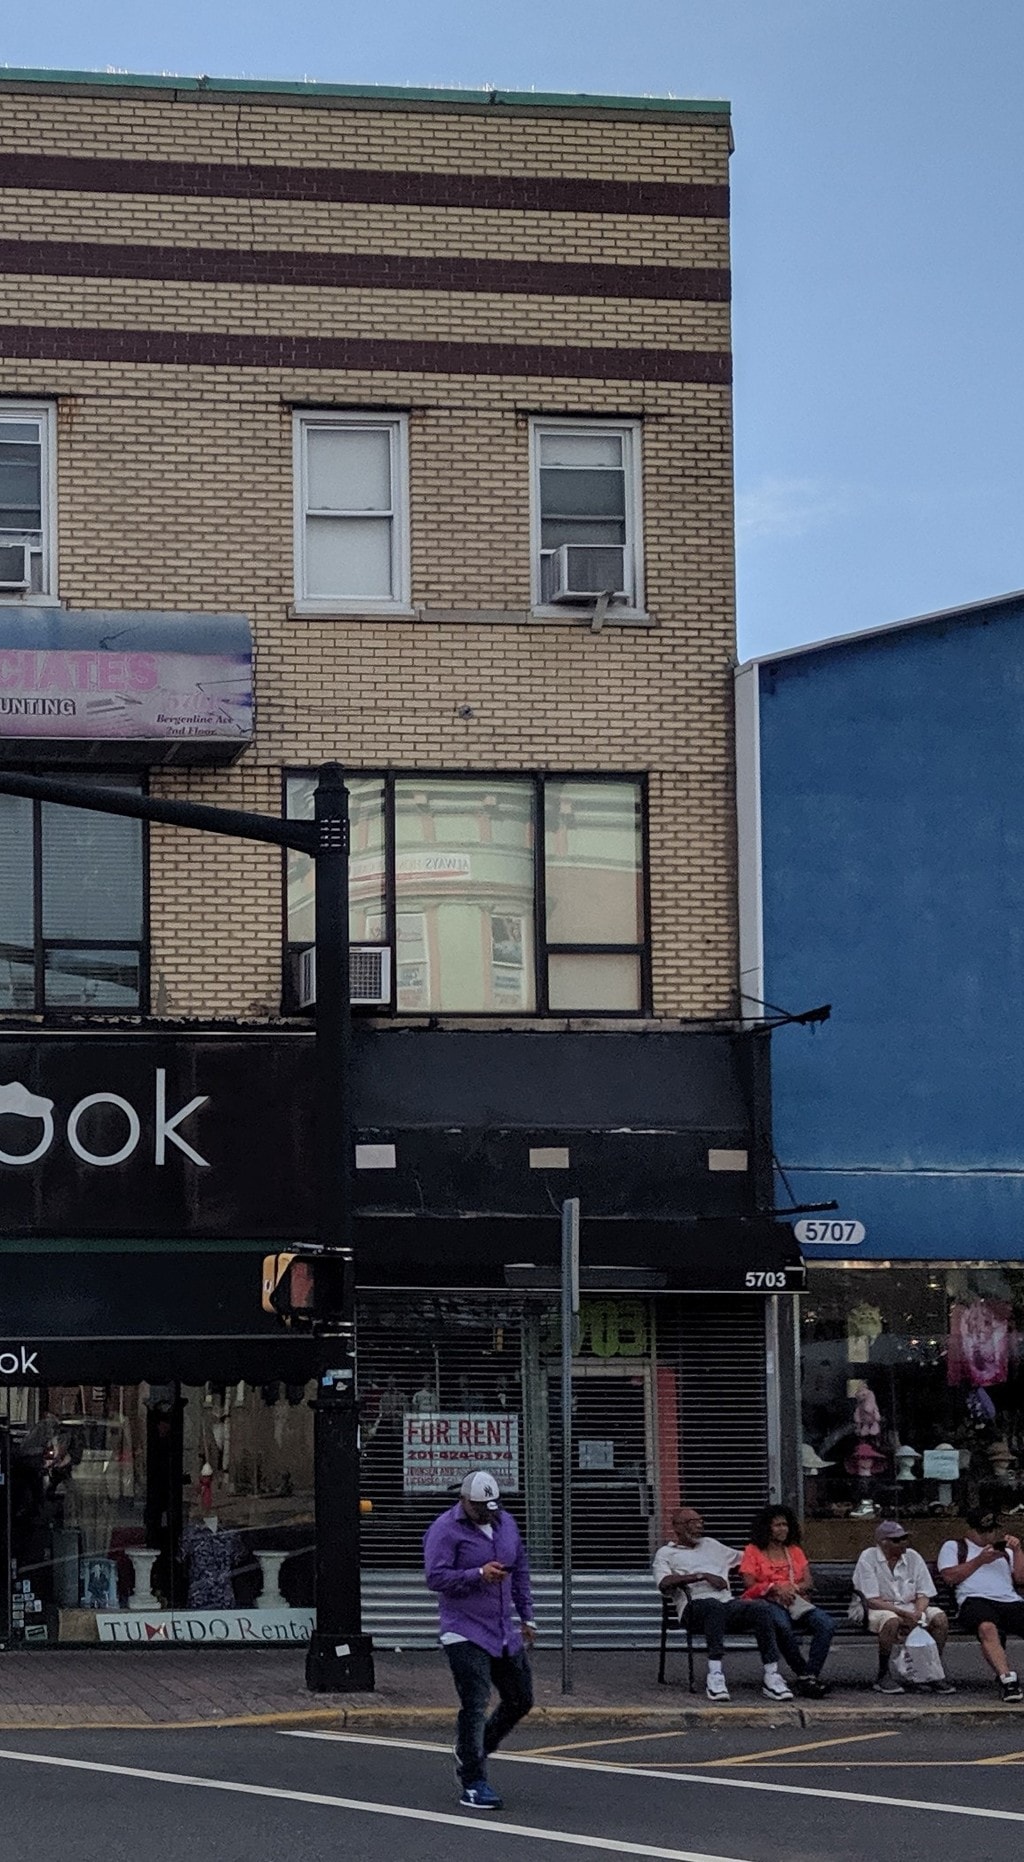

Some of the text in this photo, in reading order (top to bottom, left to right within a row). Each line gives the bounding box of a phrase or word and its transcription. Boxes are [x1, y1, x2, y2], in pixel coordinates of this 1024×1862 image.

[805, 1222, 856, 1241] 5707
[745, 1272, 787, 1287] 5703
[458, 1420, 514, 1446] RENT
[236, 1615, 318, 1641] Rental
